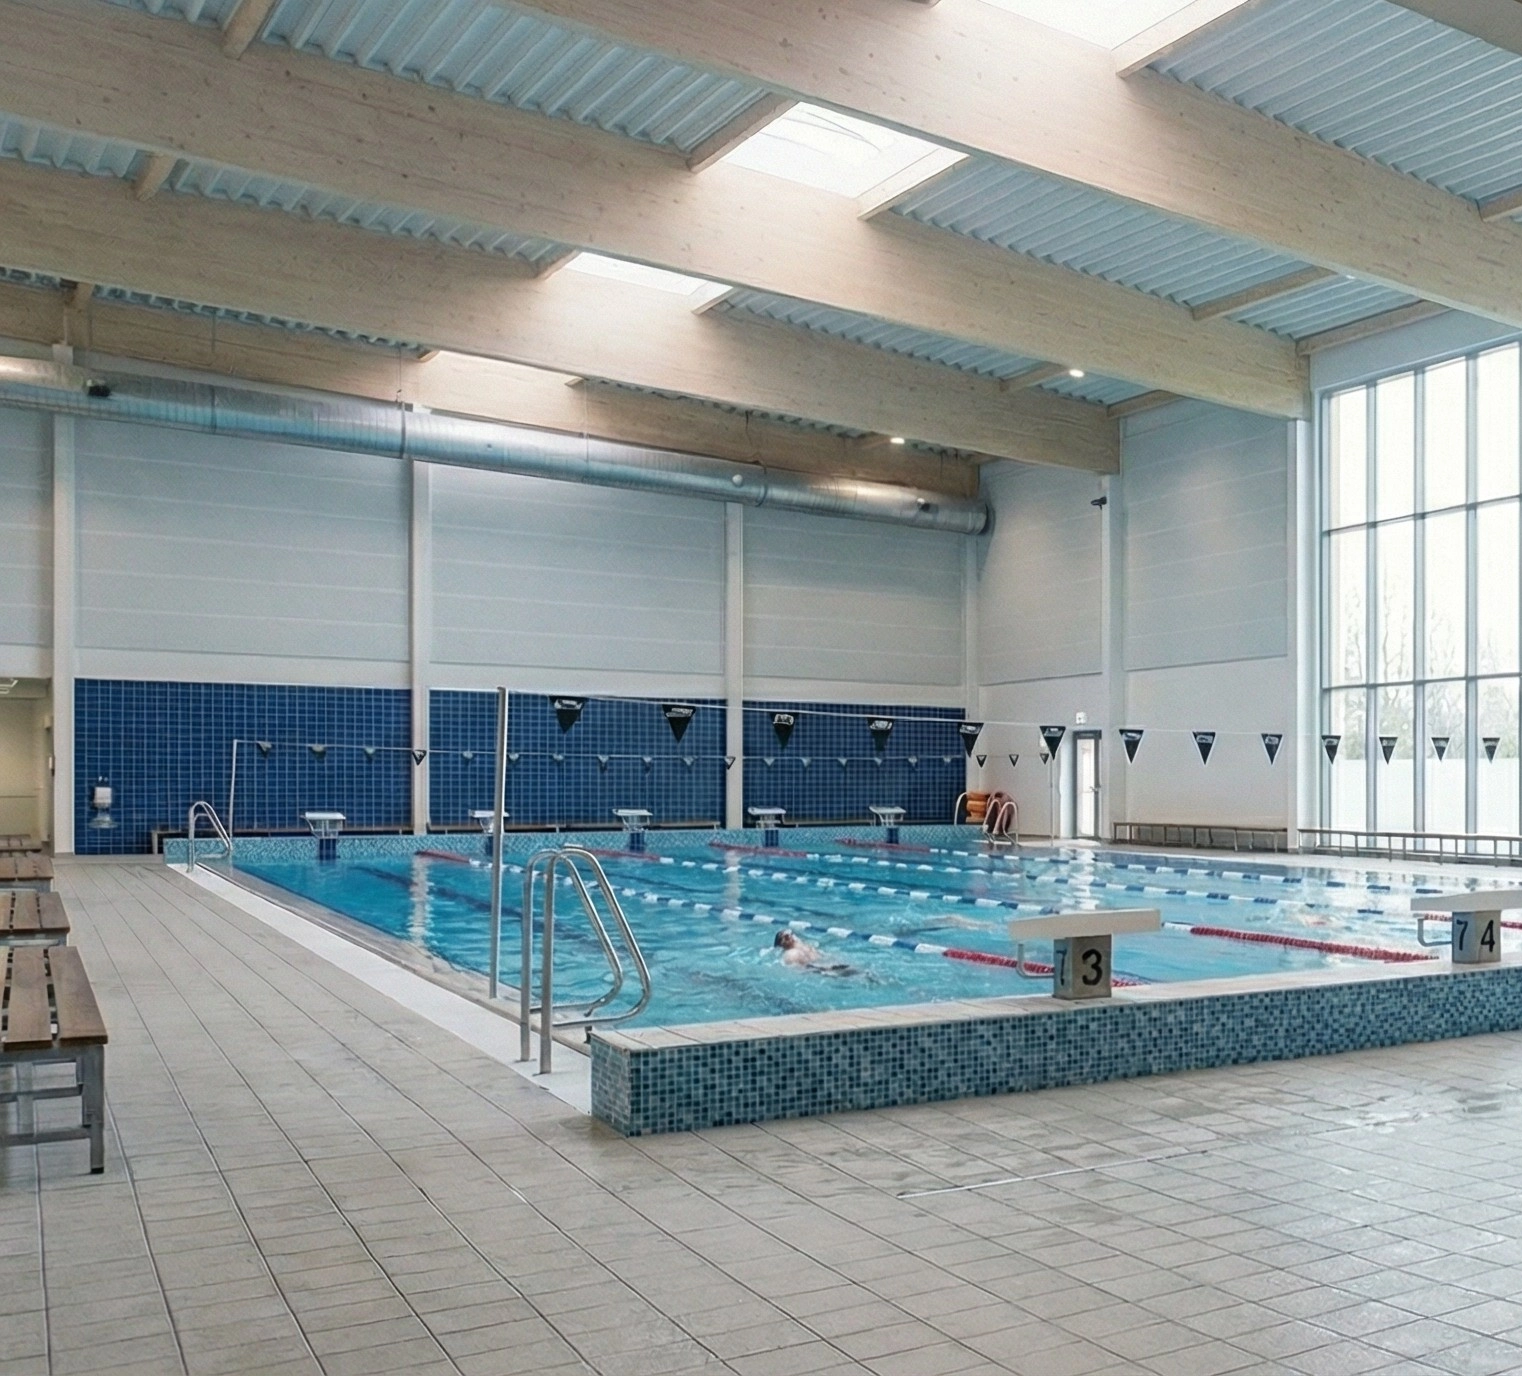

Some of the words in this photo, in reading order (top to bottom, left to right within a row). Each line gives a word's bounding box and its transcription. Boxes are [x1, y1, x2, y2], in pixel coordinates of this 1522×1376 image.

[1456, 919, 1468, 951] 7
[1481, 920, 1495, 952] 4
[1082, 949, 1102, 985] 3
